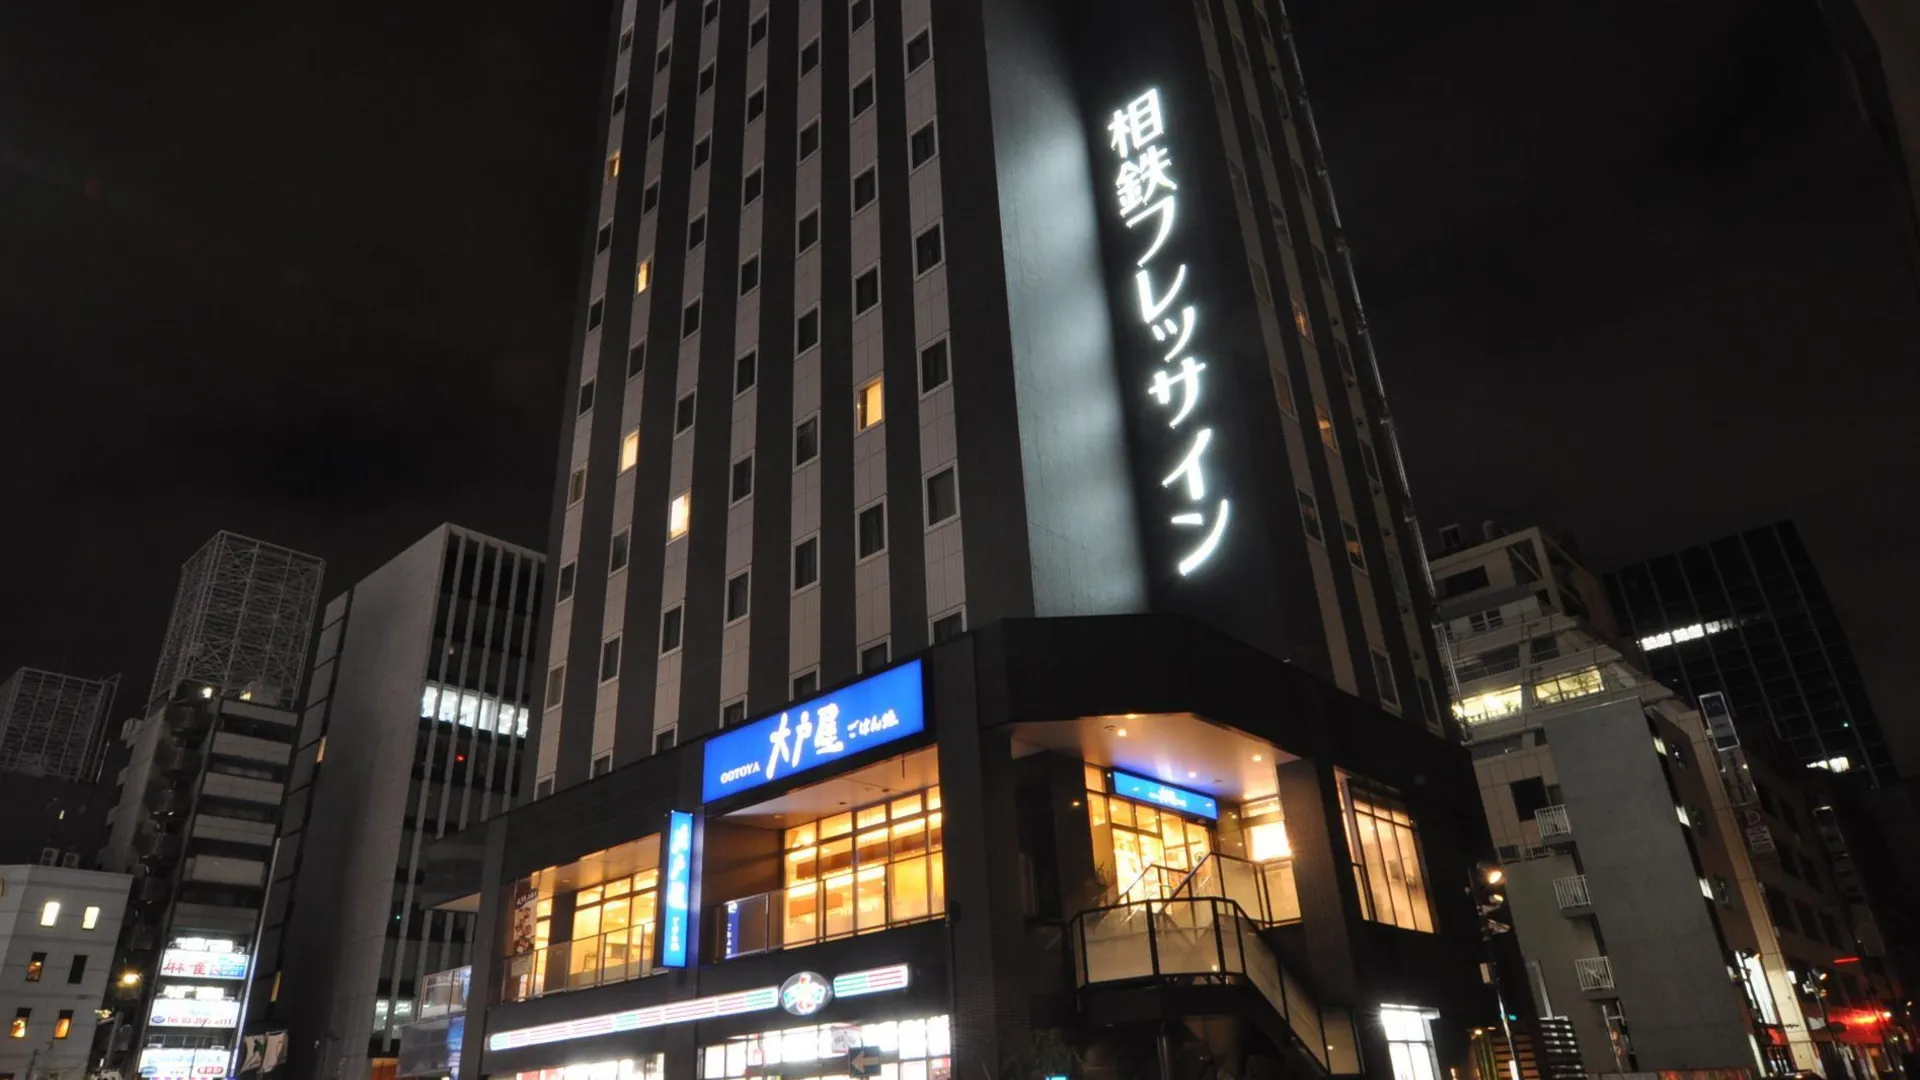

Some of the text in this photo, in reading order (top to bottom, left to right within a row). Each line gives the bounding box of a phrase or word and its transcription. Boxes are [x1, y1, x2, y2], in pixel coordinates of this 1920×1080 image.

[1107, 87, 1230, 577] 相鉄フレッサイン
[720, 761, 761, 785] OOTOYA
[765, 703, 845, 780] 大戸屋
